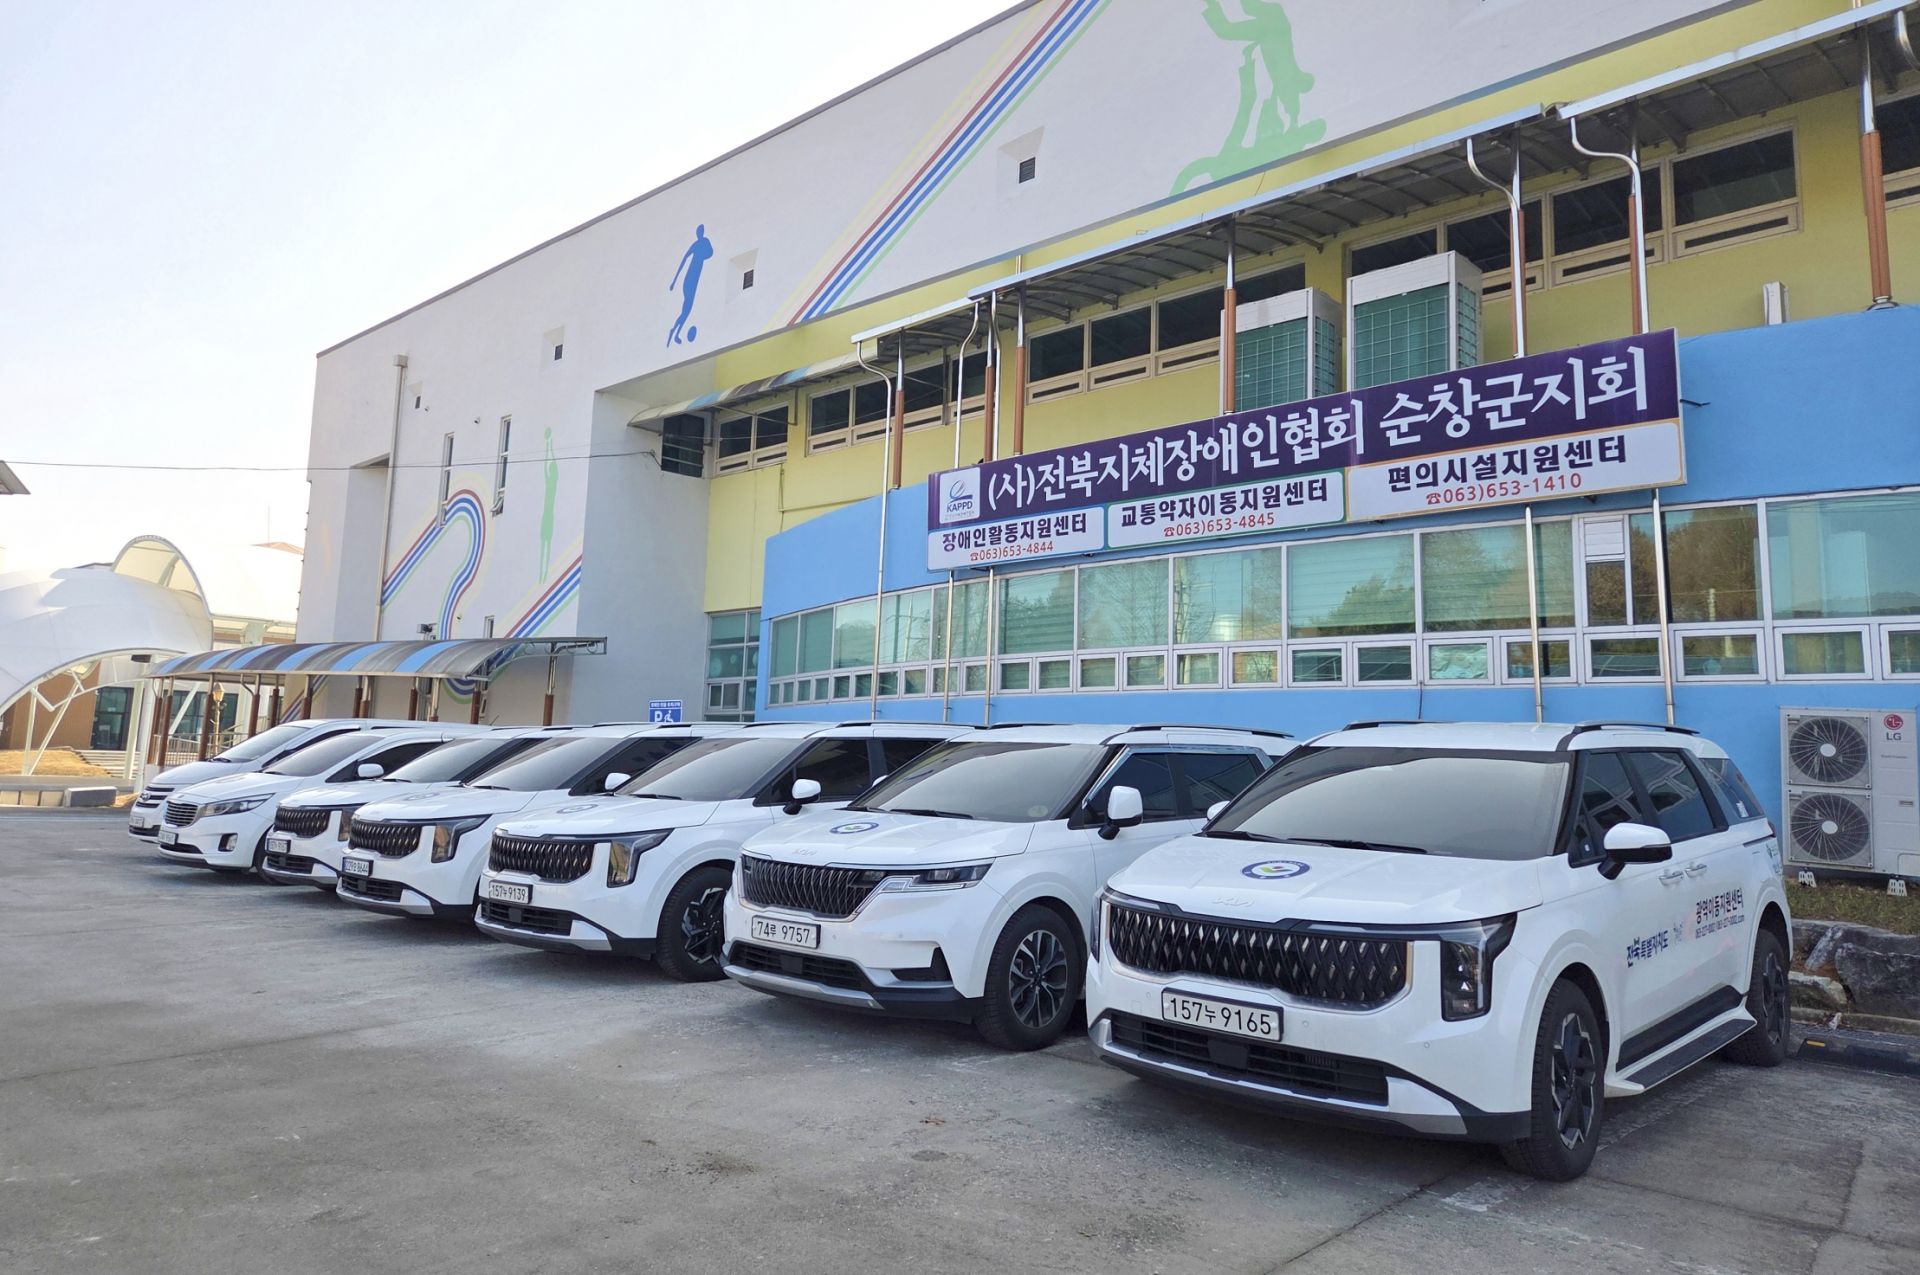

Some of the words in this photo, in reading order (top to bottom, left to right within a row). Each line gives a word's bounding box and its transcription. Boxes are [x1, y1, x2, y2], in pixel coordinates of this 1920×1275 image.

[988, 398, 1364, 511] (사)전북지체장애인협회
[1380, 346, 1647, 446] 순창군지회
[1388, 434, 1627, 492] 편의시설지원센터
[946, 500, 973, 513] KAPPD
[1121, 477, 1327, 527] 교통약자이동지원센터
[942, 513, 1087, 551] 장애인활동지원센터
[1886, 731, 1902, 741] LG
